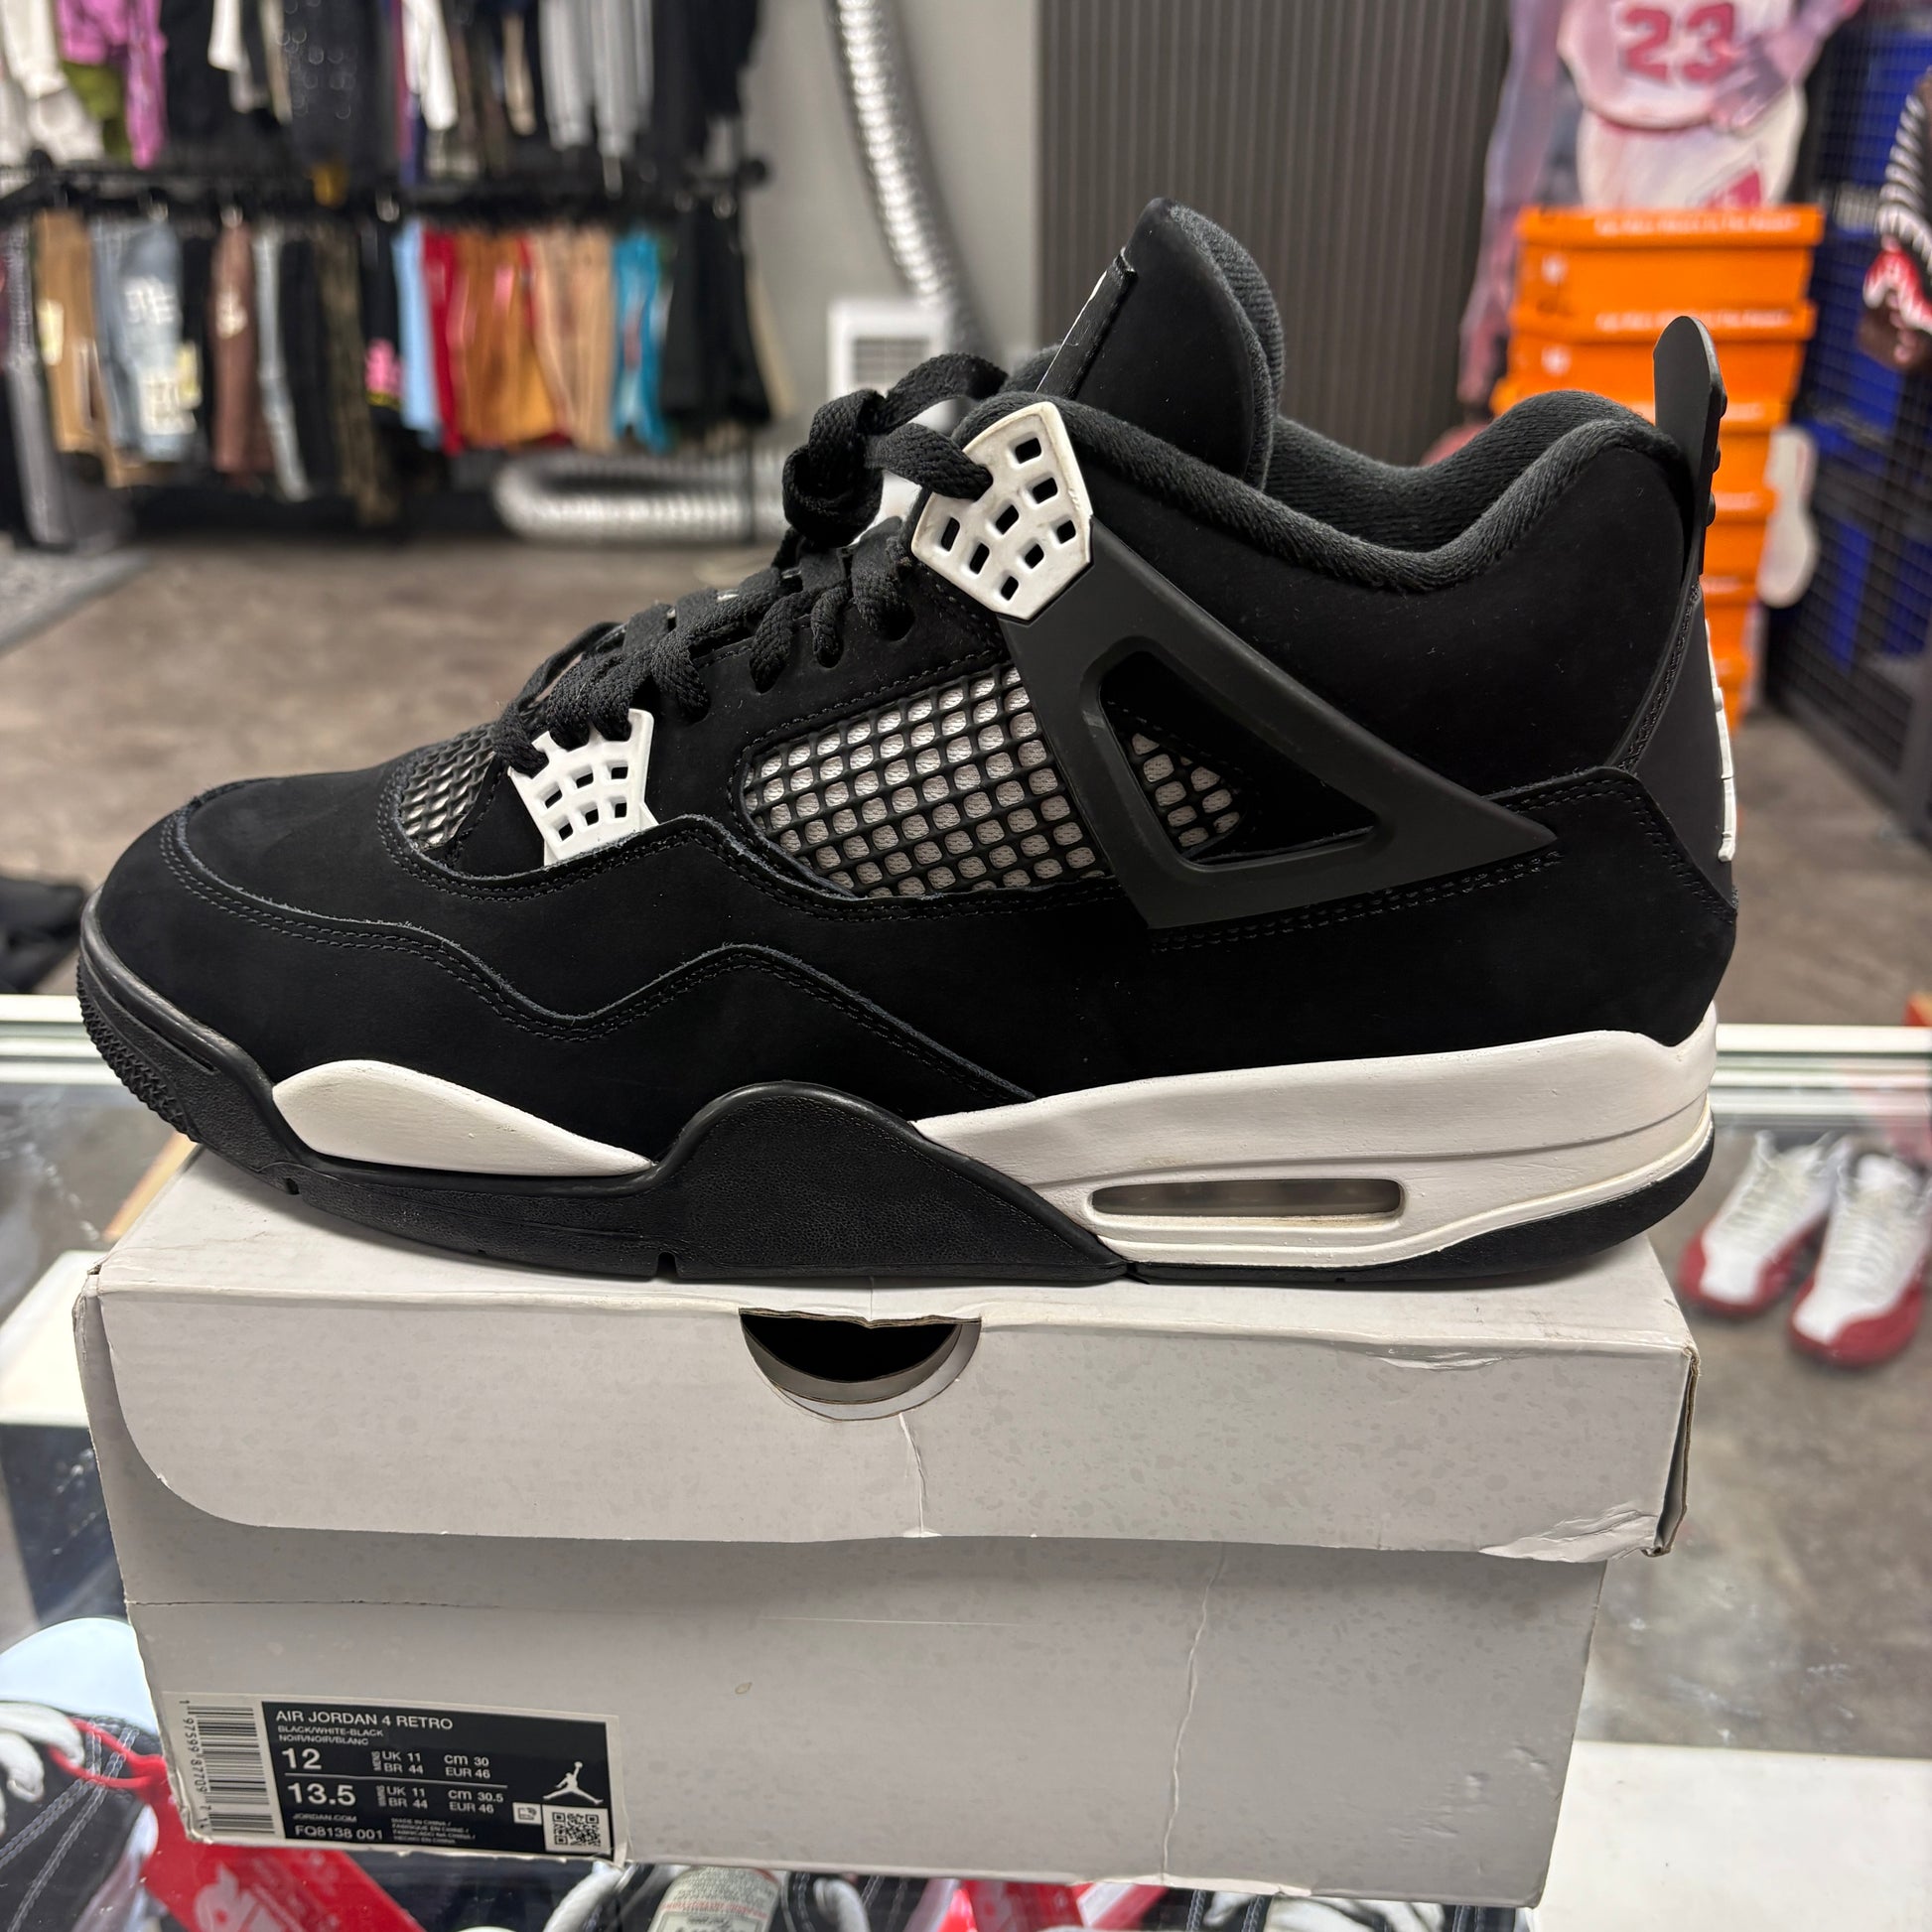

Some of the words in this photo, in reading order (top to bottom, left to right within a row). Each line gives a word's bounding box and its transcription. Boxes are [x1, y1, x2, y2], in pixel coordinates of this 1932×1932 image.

[1623, 2, 1736, 83] 23
[276, 1710, 304, 1723] AIR
[309, 1712, 377, 1725] JORDAN
[382, 1716, 391, 1726] 4
[397, 1716, 453, 1729] RETRO
[278, 1725, 384, 1737] BLACK/WHITE-BLACK
[282, 1747, 322, 1770] 12
[381, 1750, 401, 1761] UK
[408, 1752, 421, 1762] 11
[444, 1754, 469, 1765] cm
[474, 1756, 489, 1767] 30
[384, 1762, 403, 1773] BR
[408, 1764, 424, 1775] 44
[445, 1766, 473, 1778] EUR
[475, 1768, 491, 1779] 46
[287, 1782, 356, 1806] 13.5
[386, 1786, 406, 1796] UK
[412, 1788, 425, 1797] 11
[448, 1789, 473, 1800] cm
[478, 1791, 503, 1803] 30.5
[388, 1797, 408, 1808] BR
[413, 1799, 428, 1809] 44
[449, 1801, 476, 1812] EUR
[478, 1803, 494, 1814] 46
[294, 1825, 353, 1839] FQ8138
[356, 1829, 383, 1840] 001
